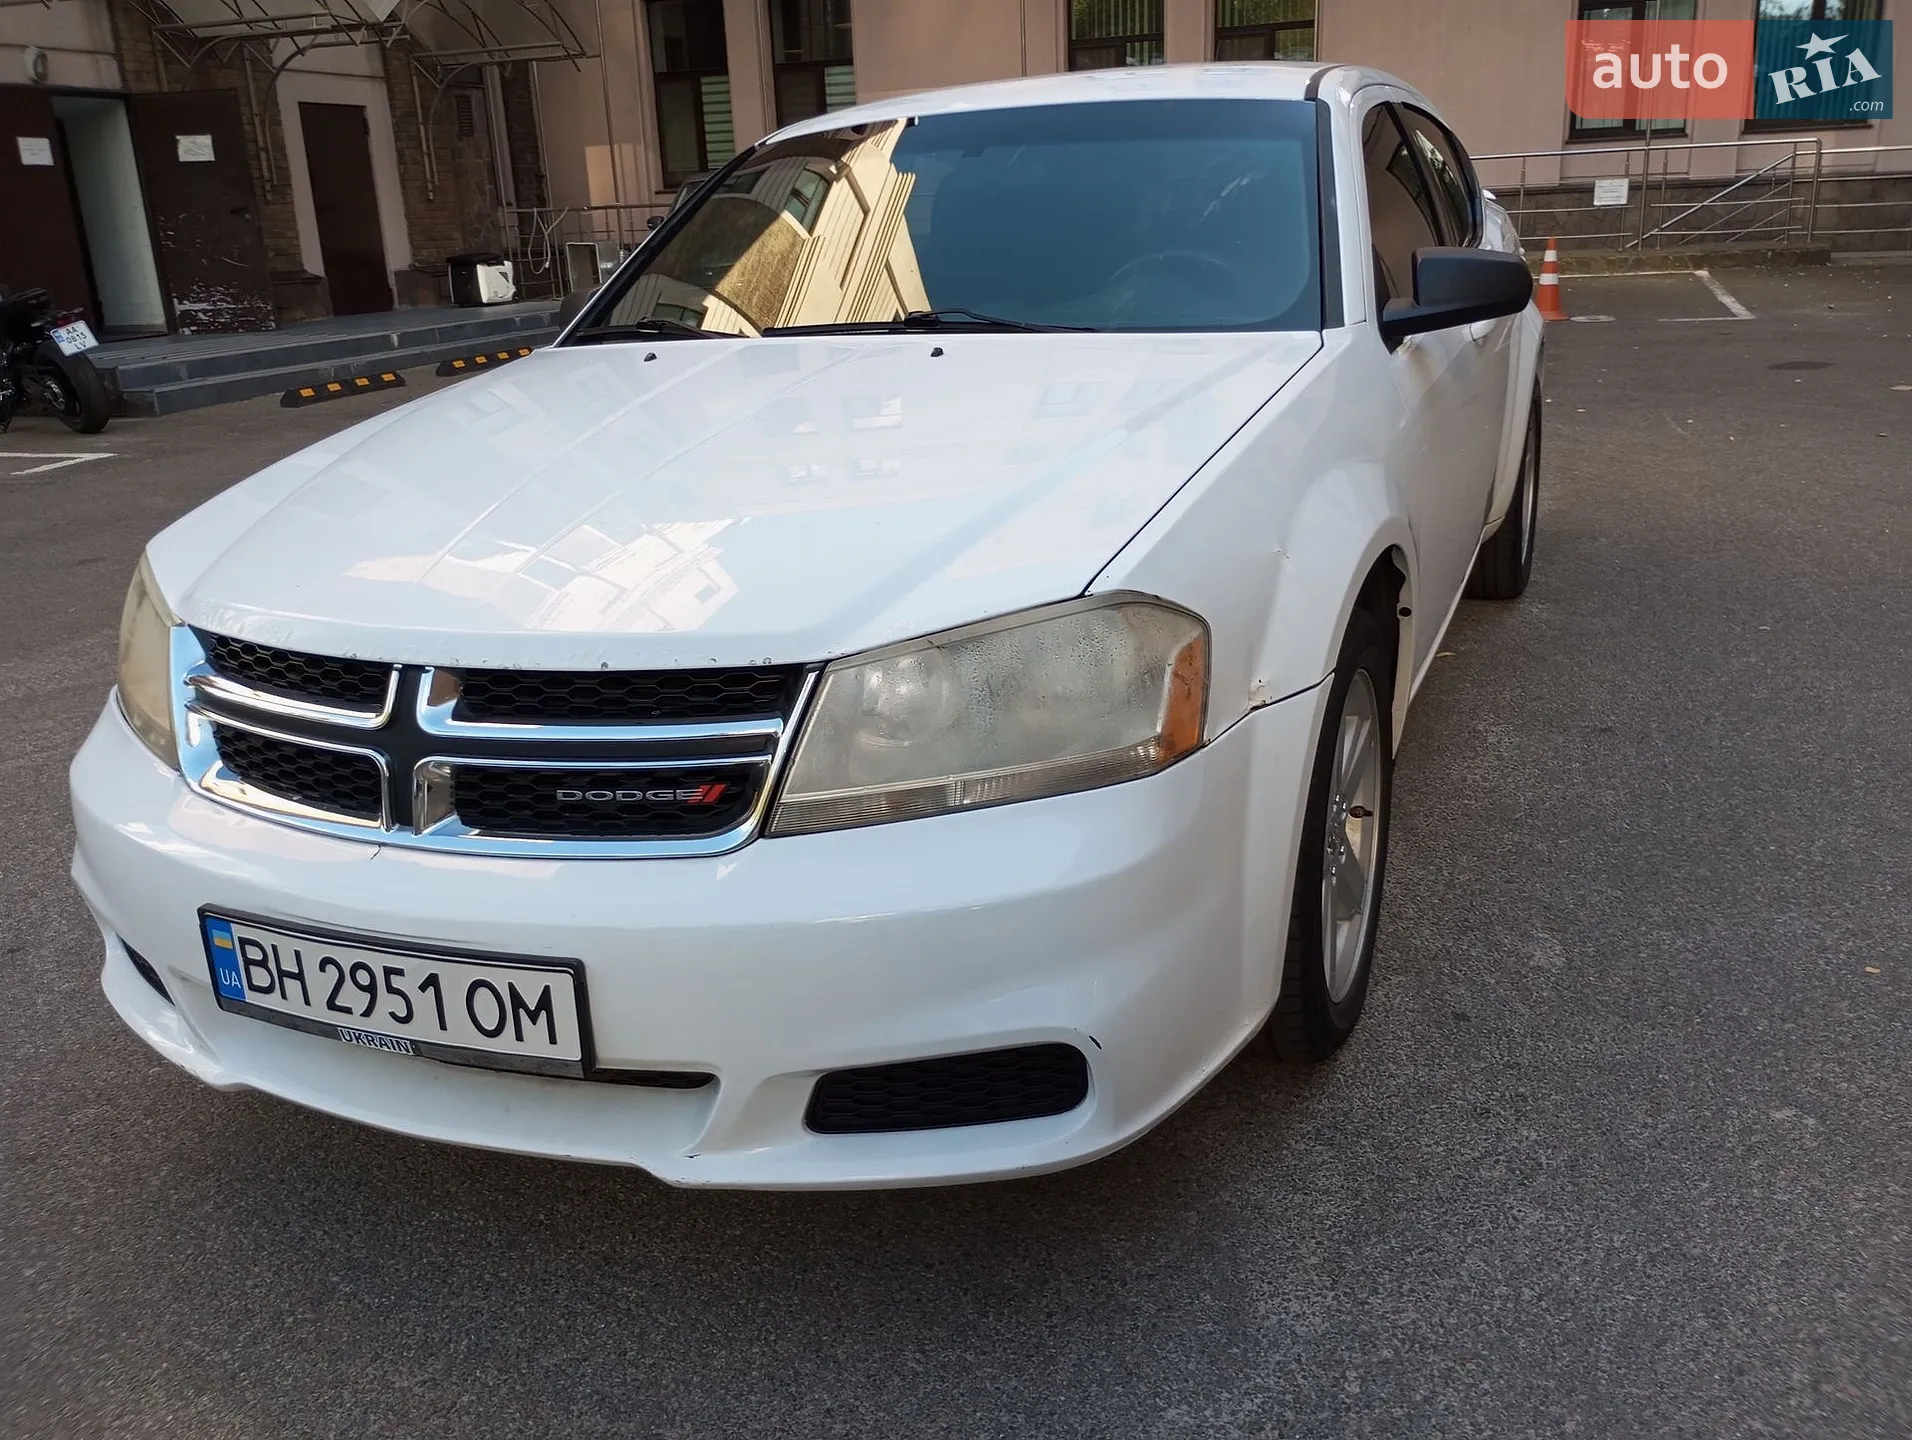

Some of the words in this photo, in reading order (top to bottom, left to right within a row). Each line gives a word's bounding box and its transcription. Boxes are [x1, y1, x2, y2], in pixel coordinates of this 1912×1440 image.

[556, 789, 703, 801] DODGE
[220, 967, 241, 989] UA
[238, 935, 312, 1007] BH
[318, 955, 448, 1031] 2951
[465, 977, 558, 1046] OM
